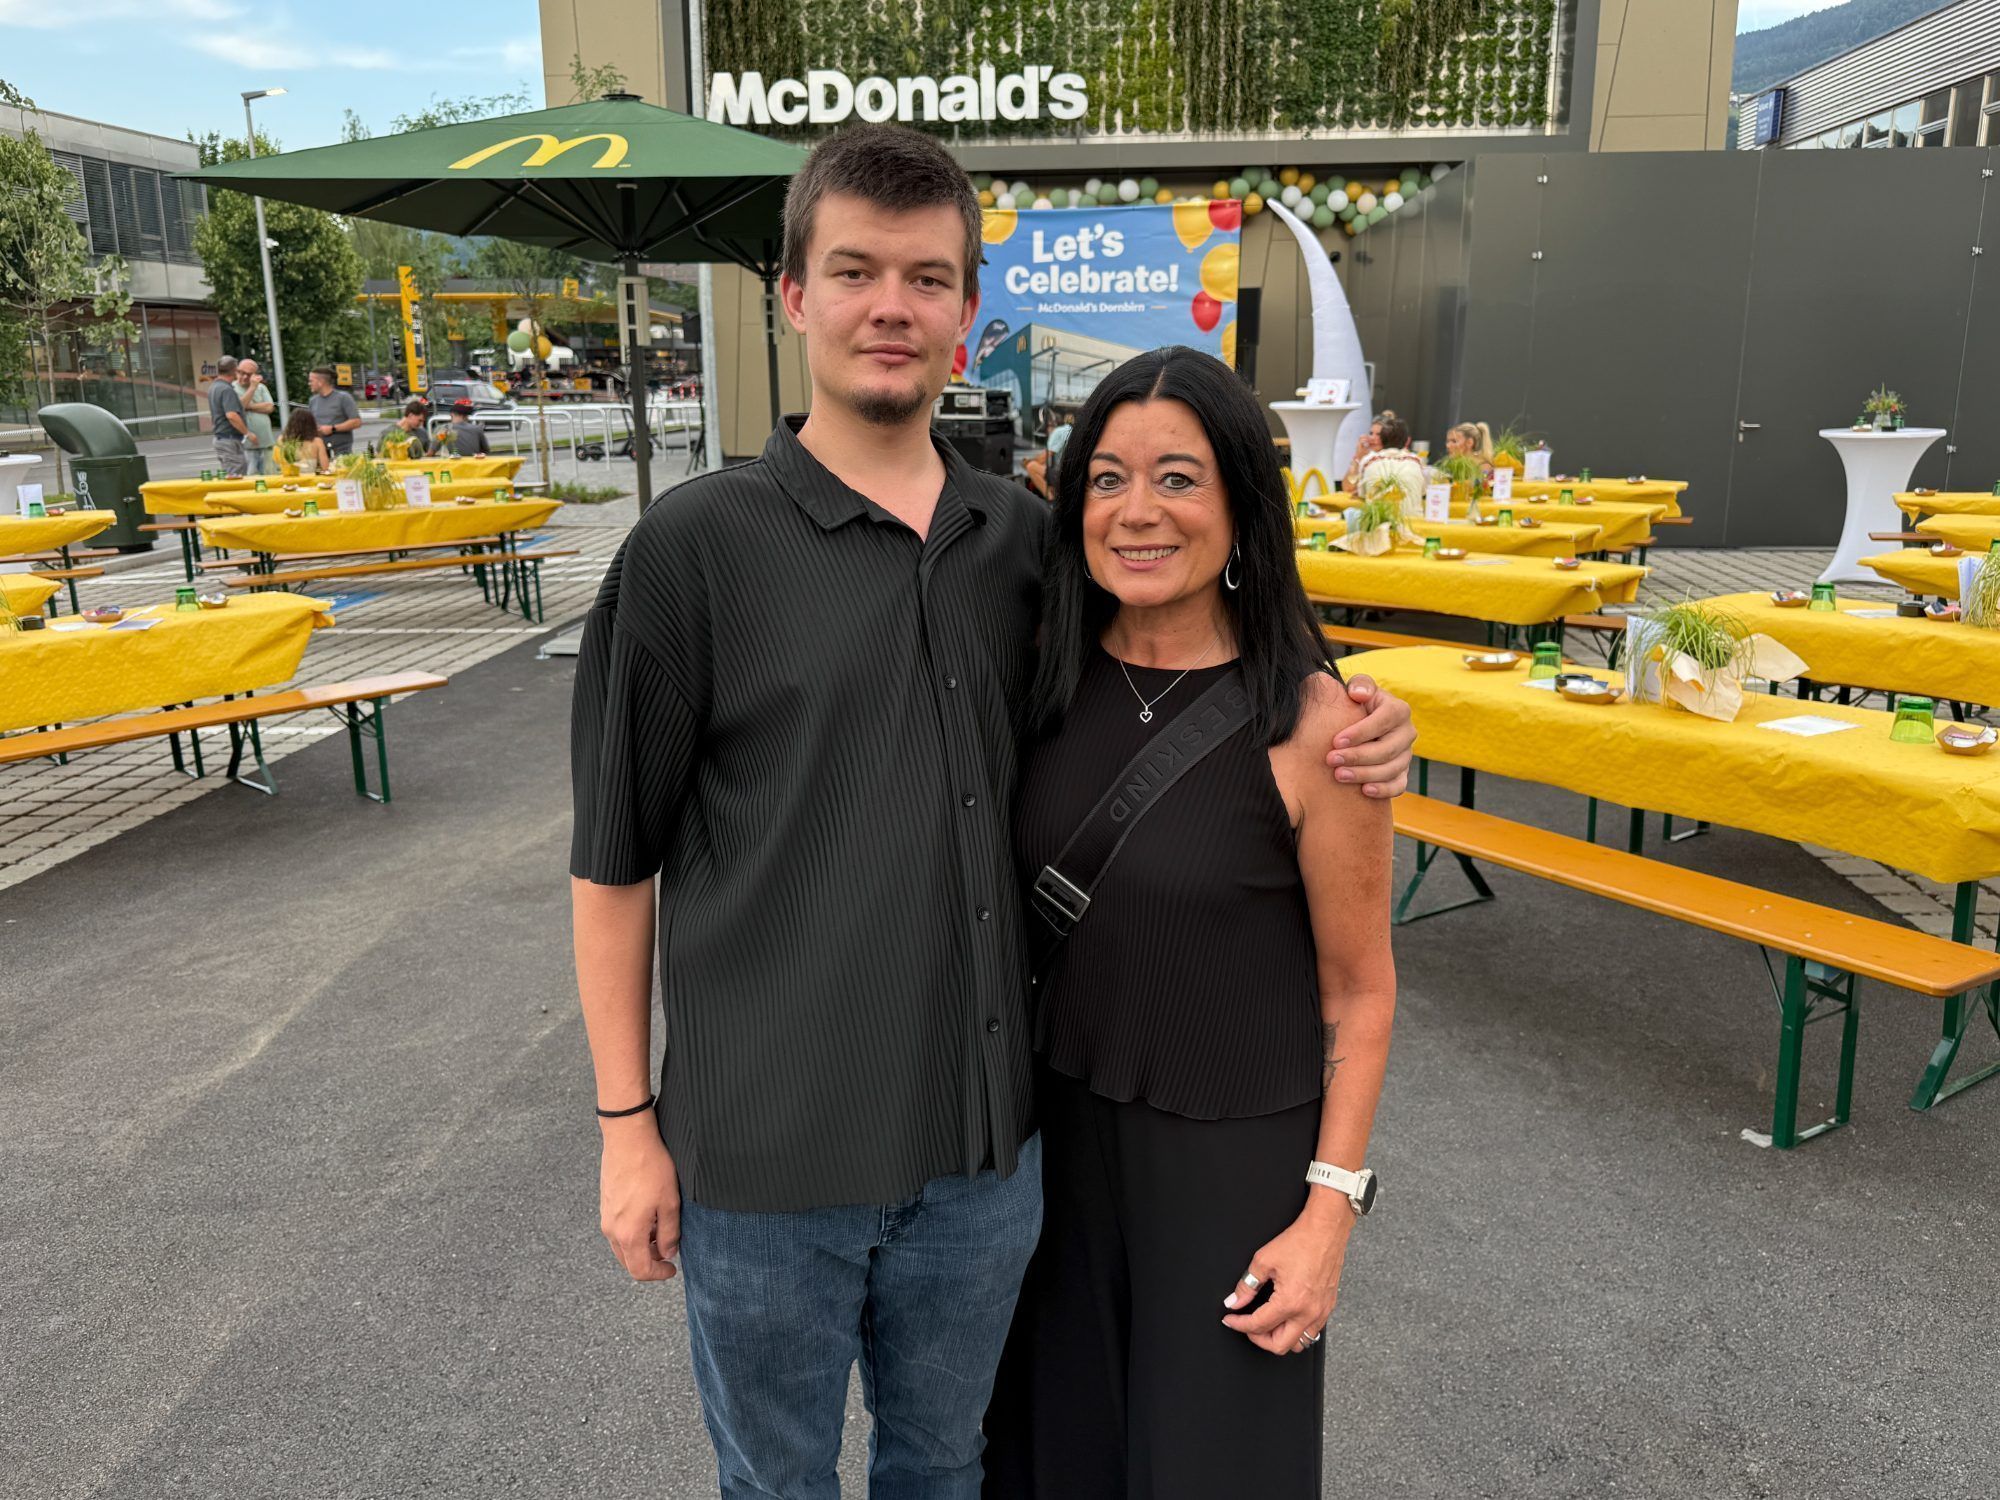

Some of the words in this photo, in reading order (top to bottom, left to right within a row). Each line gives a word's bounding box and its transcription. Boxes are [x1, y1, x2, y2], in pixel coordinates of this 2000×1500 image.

[706, 64, 1089, 126] McDonald's
[1032, 222, 1125, 264] Let's
[1004, 264, 1180, 295] Celebrate!
[1037, 302, 1098, 314] McDonald's
[1099, 301, 1146, 313] Dornbirn
